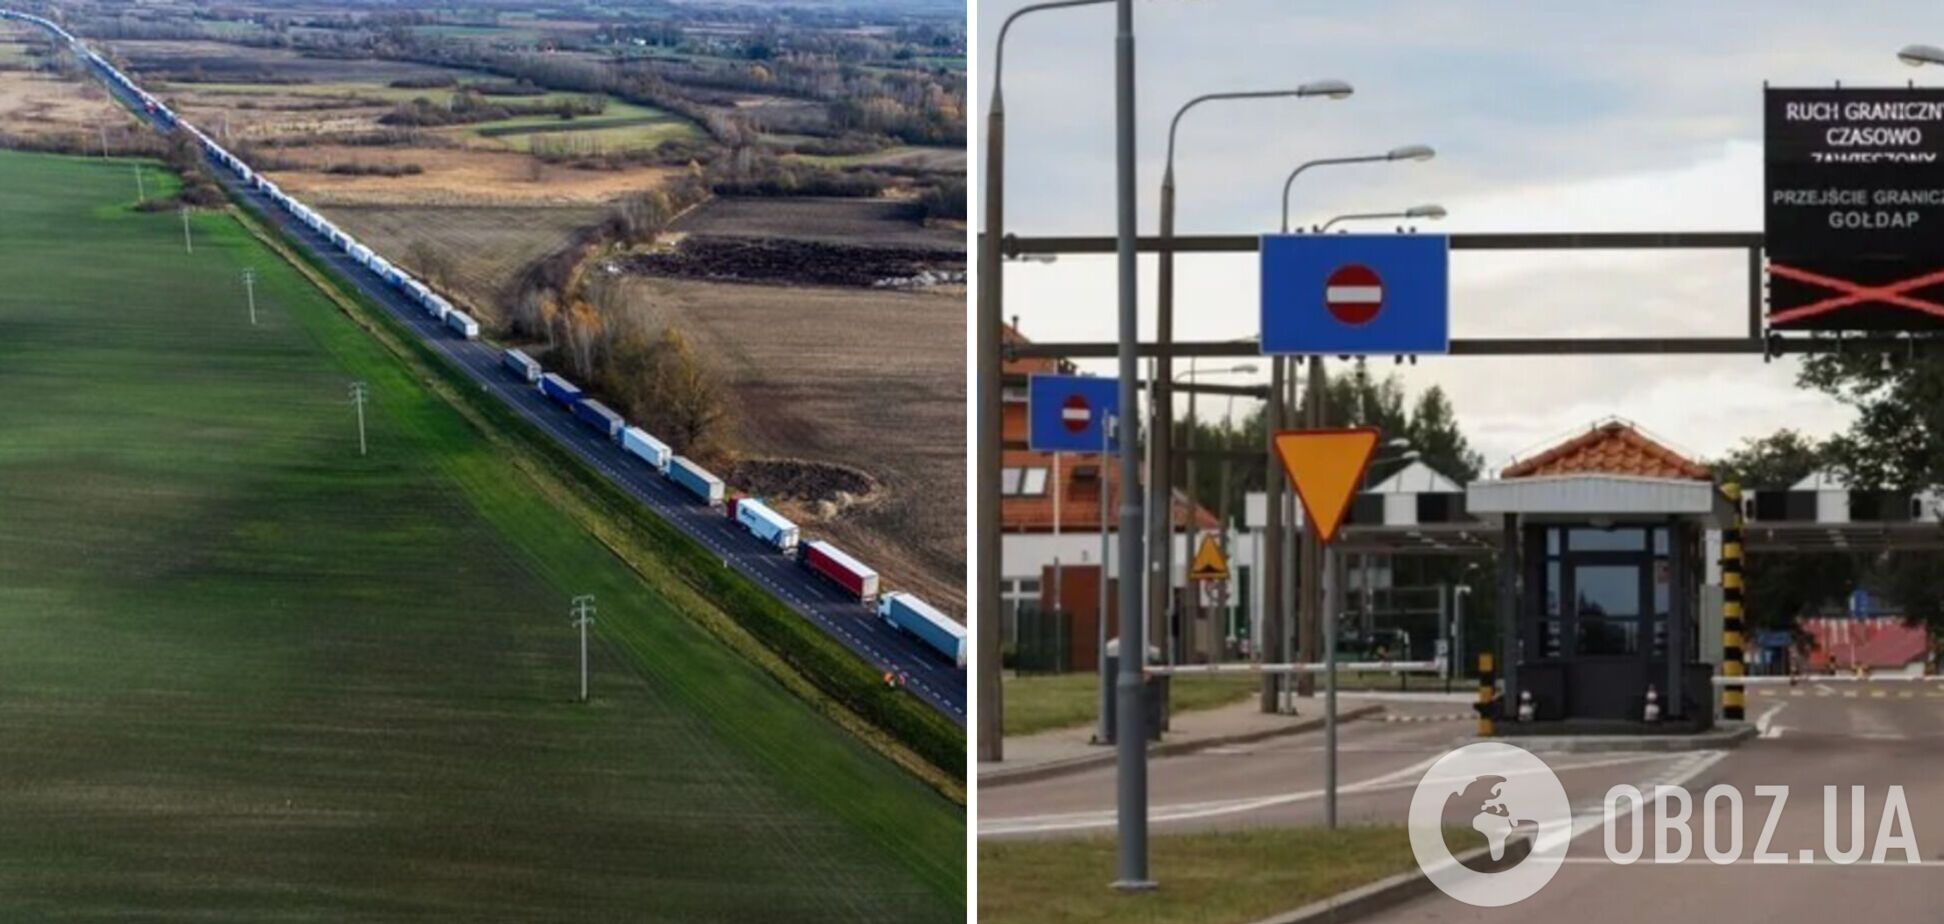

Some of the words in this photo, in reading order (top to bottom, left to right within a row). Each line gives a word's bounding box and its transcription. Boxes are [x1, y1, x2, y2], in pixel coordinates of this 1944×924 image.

[1787, 102, 1839, 120] RUCH
[1826, 128, 1922, 145] CZASOWO
[1773, 189, 1867, 205] PRZEJŚCIE
[1829, 212, 1920, 228] GOŁDAP
